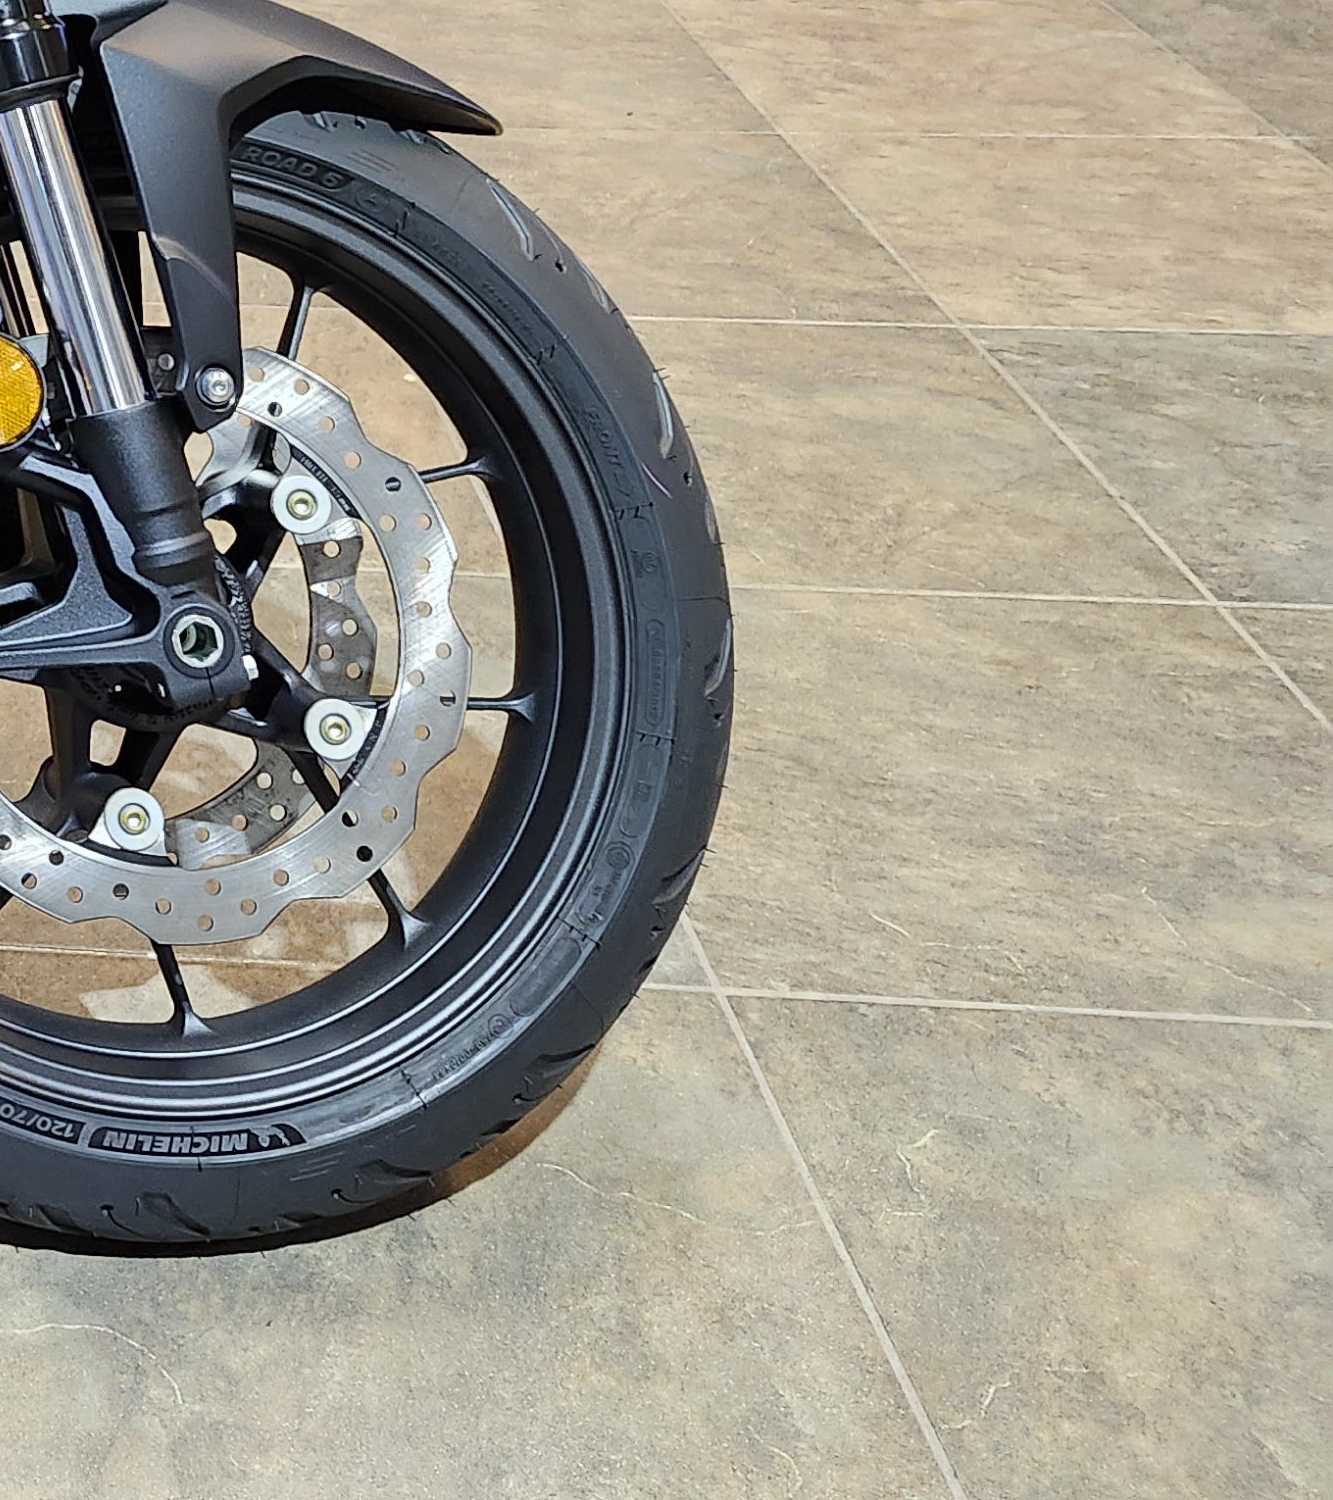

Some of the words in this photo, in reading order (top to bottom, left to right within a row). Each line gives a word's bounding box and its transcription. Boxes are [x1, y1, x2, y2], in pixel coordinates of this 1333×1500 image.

[241, 145, 318, 178] ROAD
[321, 171, 344, 188] 6
[0, 1102, 77, 1139] 120/70
[102, 1130, 248, 1154] MICHELIN
